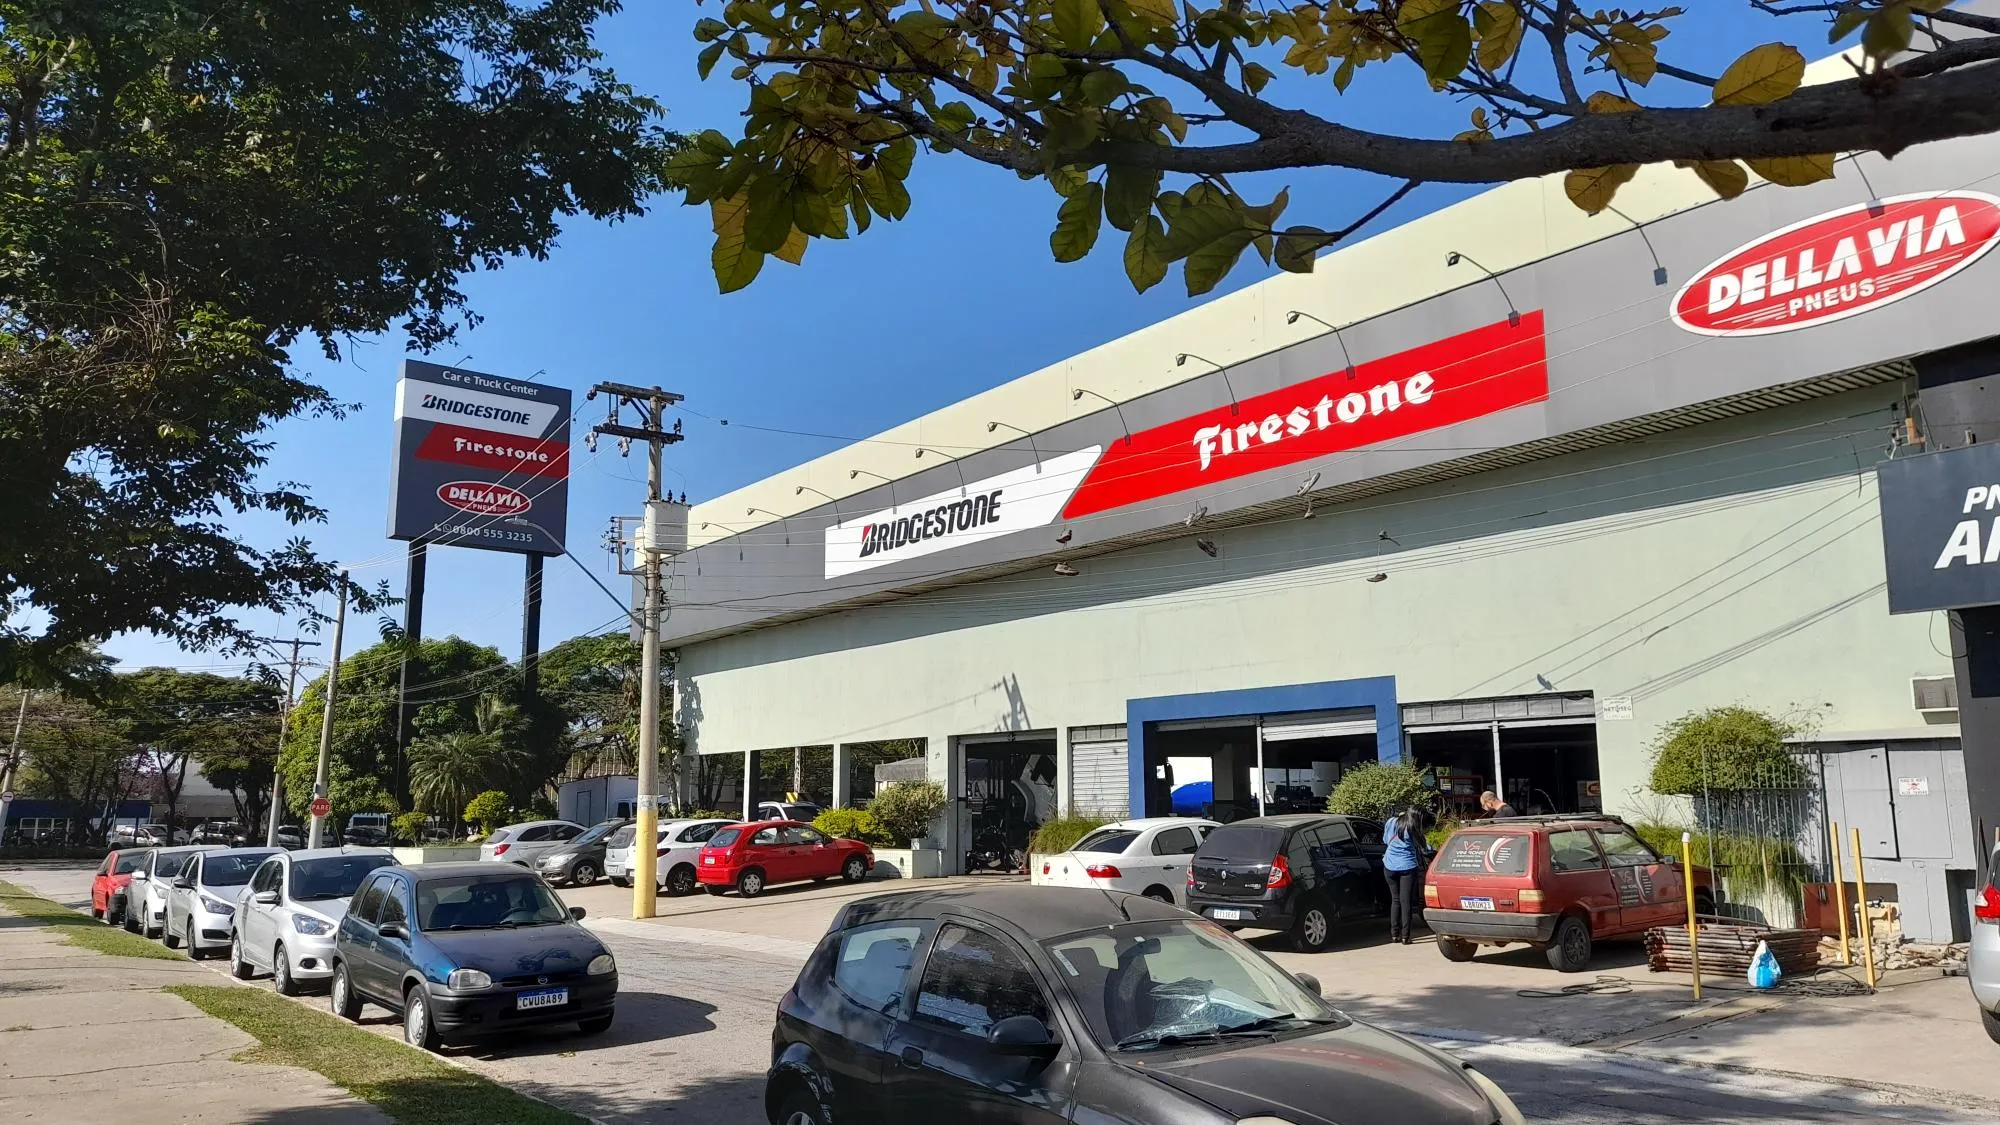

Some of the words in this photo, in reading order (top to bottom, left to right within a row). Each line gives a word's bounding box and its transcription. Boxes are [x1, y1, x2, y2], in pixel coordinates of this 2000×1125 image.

[1789, 278, 1876, 316] PNEUS
[442, 371, 461, 382] Car
[464, 376, 471, 384] e
[473, 376, 501, 389] Truck
[503, 382, 538, 396] Center
[421, 394, 531, 426] BRIDGESTONE
[1193, 371, 1435, 471] Firestone
[453, 437, 549, 463] Firestone
[453, 525, 480, 536] 0800
[483, 528, 503, 539] 555
[506, 531, 533, 542] 3235
[859, 489, 1003, 558] BRIDGESTONE
[522, 993, 563, 1008] CWU8A89
